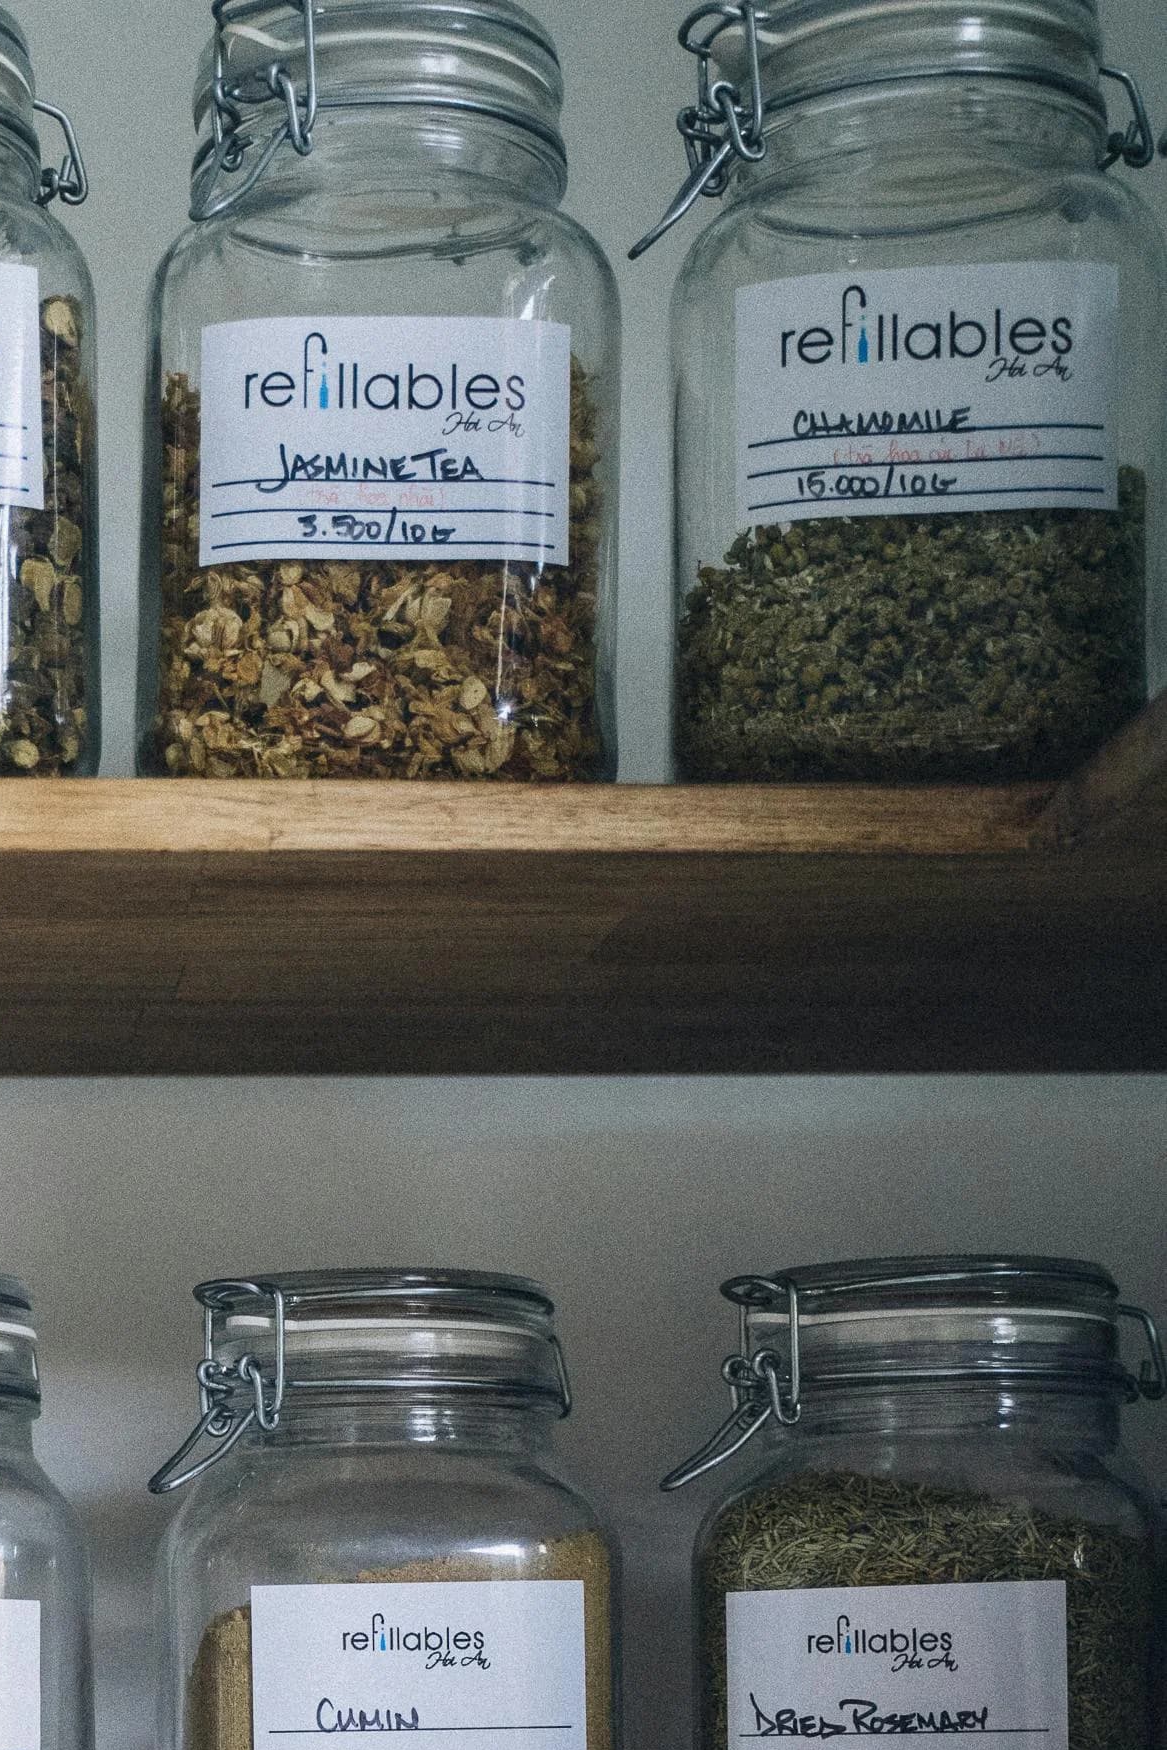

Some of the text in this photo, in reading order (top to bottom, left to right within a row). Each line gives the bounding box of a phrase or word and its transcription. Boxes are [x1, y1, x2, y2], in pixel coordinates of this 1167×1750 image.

[781, 285, 1073, 367] refillables
[244, 332, 525, 410] refillables
[793, 406, 972, 438] CHAMOMILE
[255, 443, 484, 493] JASMINE TEA
[342, 1613, 484, 1651] refillables
[807, 1614, 953, 1655] refillables
[316, 1697, 419, 1733] CUMIN
[749, 1692, 989, 1739] DRIED ROSEMARY
